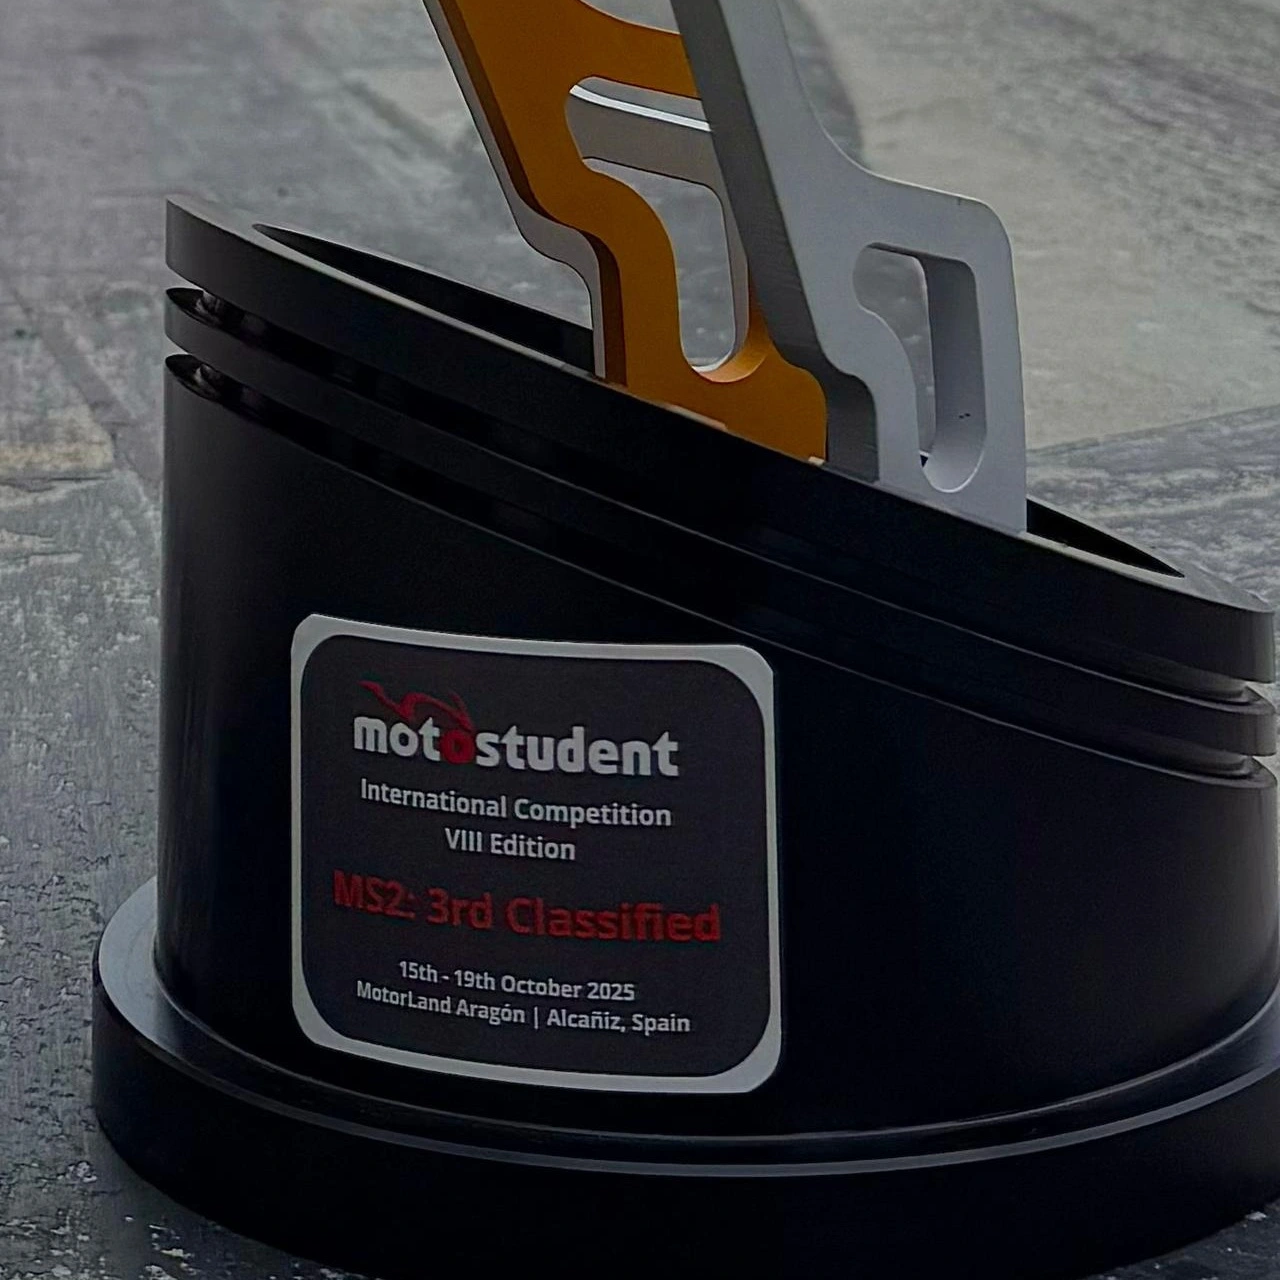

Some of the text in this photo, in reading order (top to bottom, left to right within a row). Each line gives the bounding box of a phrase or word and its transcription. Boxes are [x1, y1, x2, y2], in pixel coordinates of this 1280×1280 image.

[353, 715, 680, 777] motostudent
[360, 777, 673, 830] International Competition
[444, 827, 577, 862] VIII Edition
[332, 869, 721, 942] MS2: 3rd Classified
[356, 979, 452, 1015] MotorLand
[455, 998, 526, 1026] Aragón
[545, 1007, 627, 1033] Alcañiz,
[631, 1012, 691, 1037] Spain
[398, 959, 439, 984] 15th
[453, 968, 496, 991] 19th
[500, 974, 583, 1000] October
[586, 981, 636, 1002] 2025
